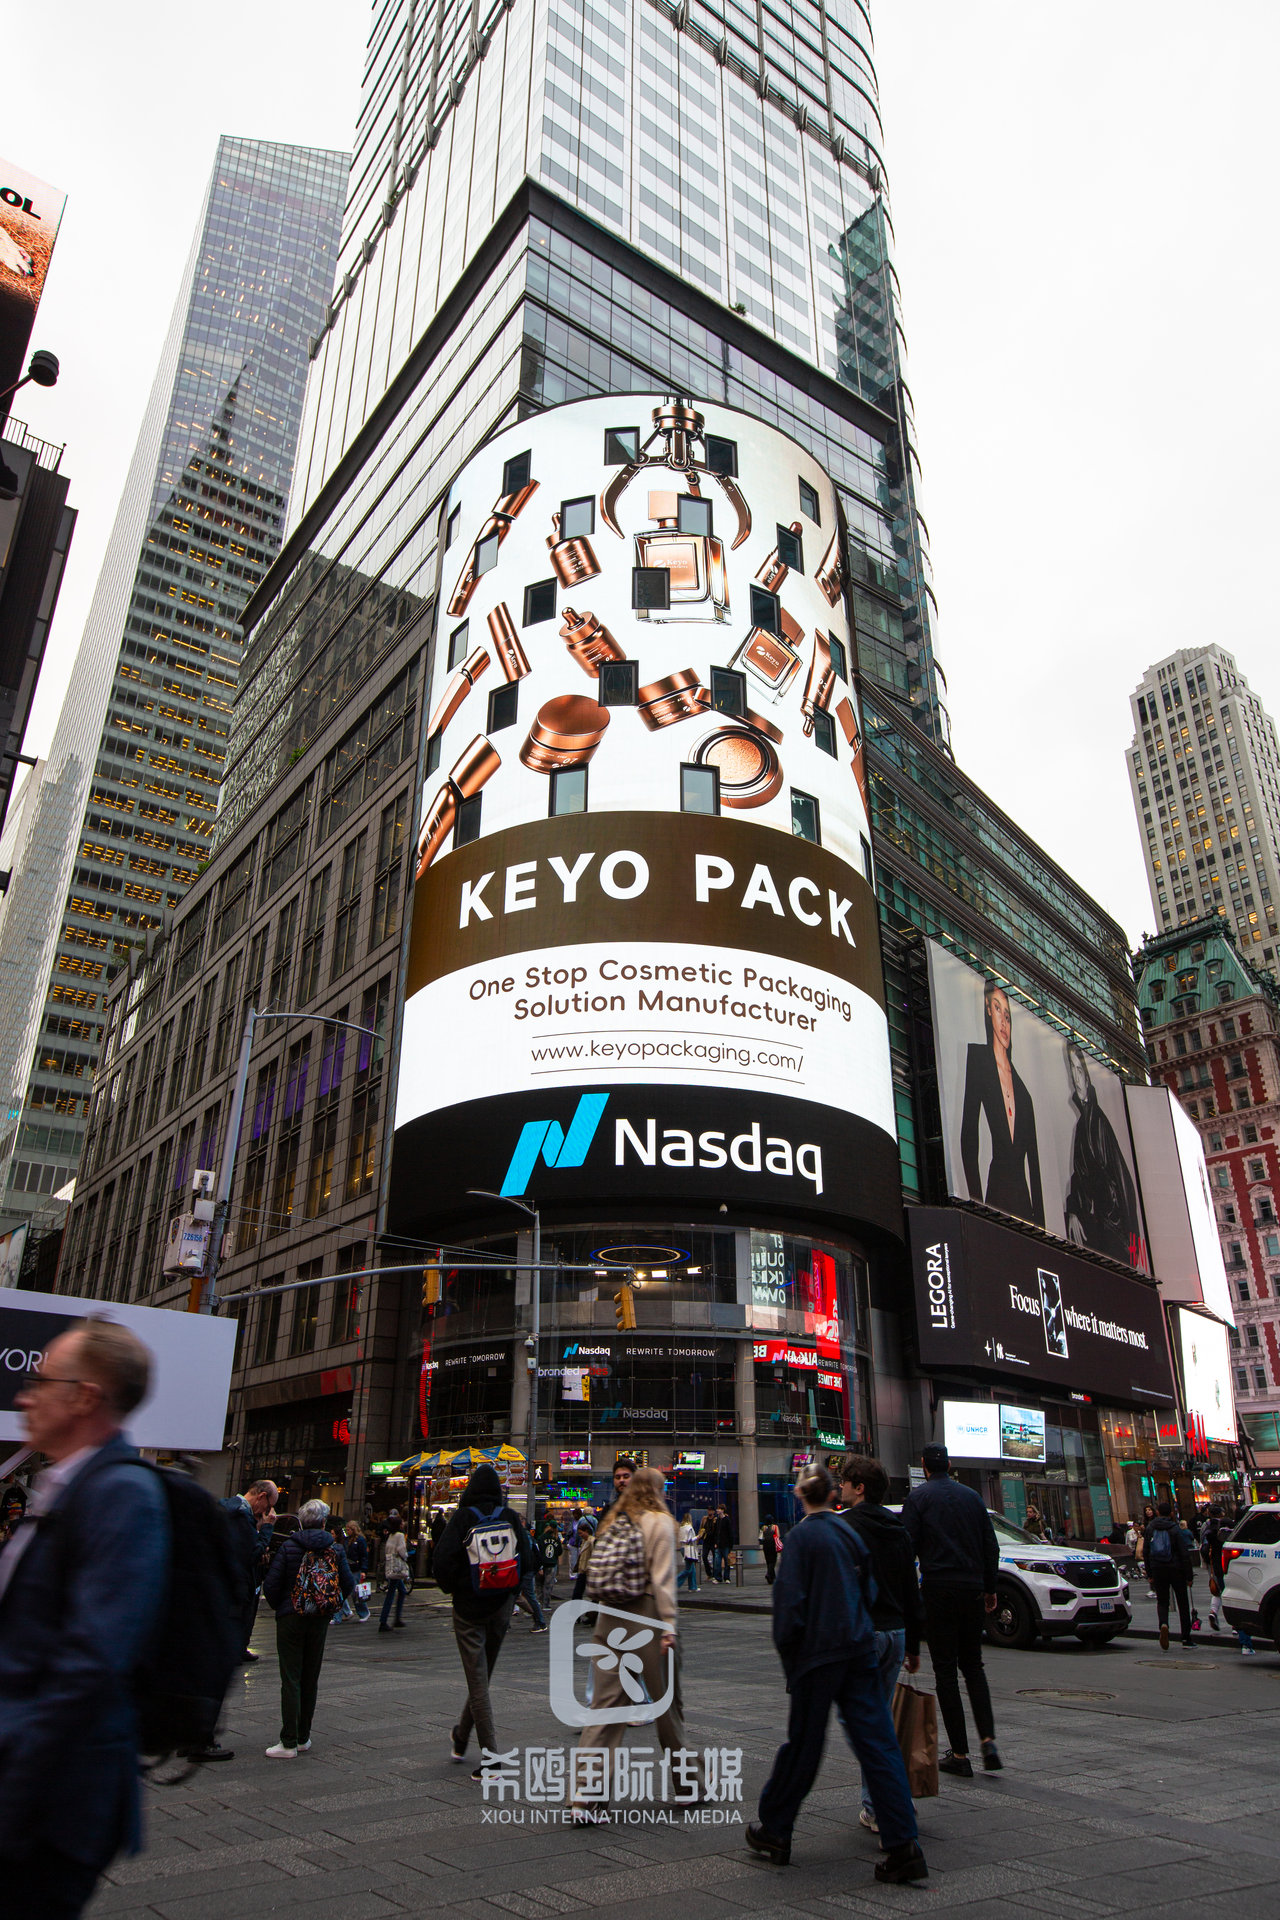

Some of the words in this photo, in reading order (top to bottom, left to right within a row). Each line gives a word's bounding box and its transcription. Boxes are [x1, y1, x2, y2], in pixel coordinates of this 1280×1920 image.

[764, 651, 780, 667] Keyo
[459, 850, 650, 929] KEYO
[695, 854, 857, 948] PACK
[469, 972, 516, 1001] One
[525, 961, 588, 989] Stop
[598, 959, 733, 987] Cosmetic
[743, 967, 852, 1021] Packaging
[513, 993, 626, 1021] Solution
[638, 990, 818, 1033] Manufacturer
[531, 1040, 804, 1073] www.keyopackaging.com/
[614, 1118, 824, 1196] Nasdaq
[926, 1243, 948, 1329] LEGORA
[1009, 1284, 1041, 1317] Focus
[1064, 1305, 1092, 1332] where
[1090, 1311, 1099, 1335] it
[1098, 1319, 1129, 1344] matters
[1127, 1329, 1149, 1350] most.
[578, 1346, 611, 1356] Nasdaq
[626, 1347, 664, 1356] REWRITE
[667, 1348, 717, 1357] TOMORROW
[818, 1358, 839, 1369] REWRITE
[622, 1407, 668, 1421] Nasdaq
[966, 1425, 988, 1433] UNHCR
